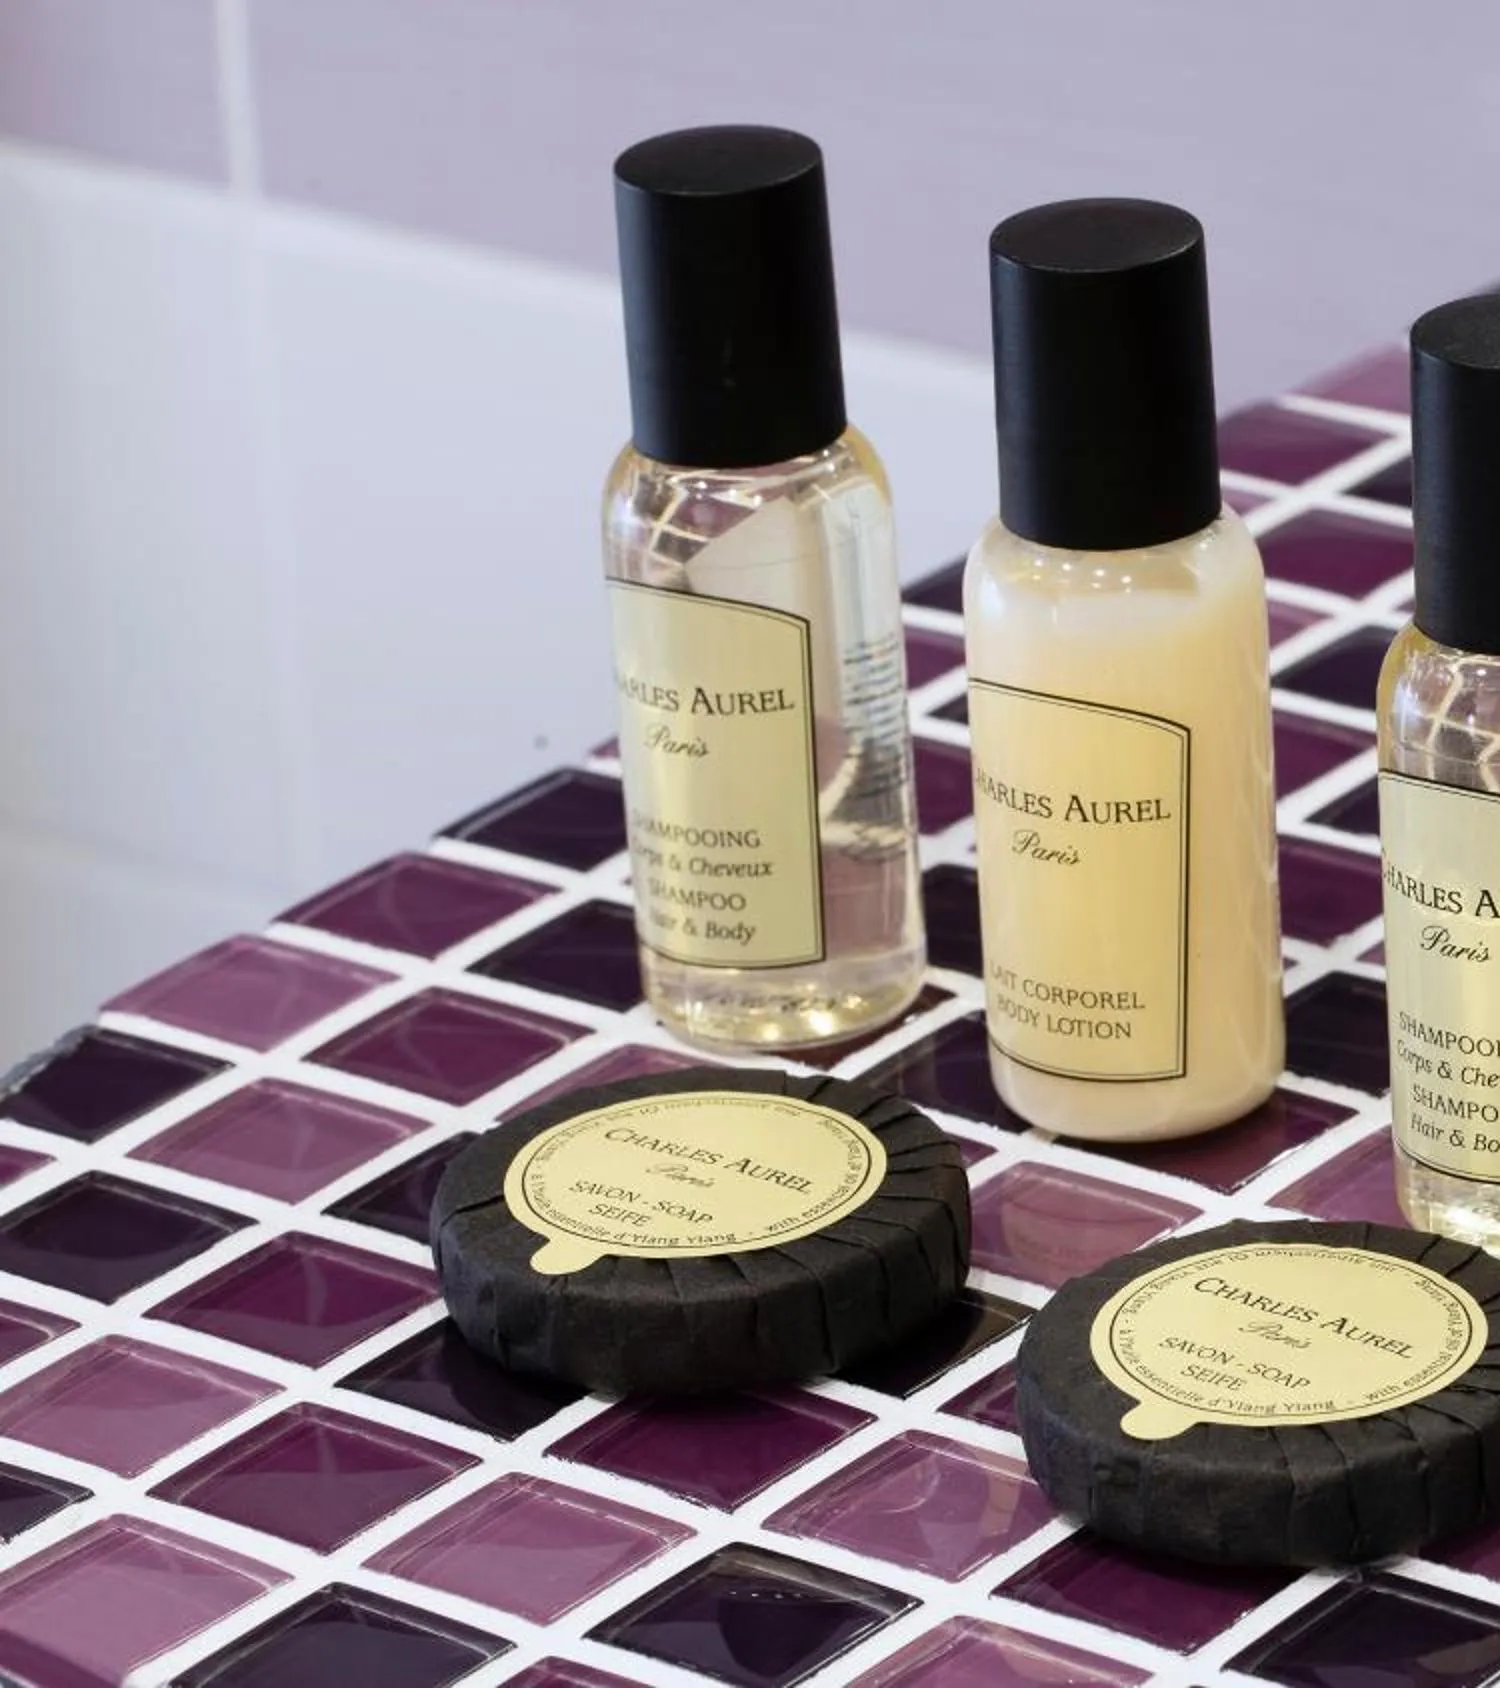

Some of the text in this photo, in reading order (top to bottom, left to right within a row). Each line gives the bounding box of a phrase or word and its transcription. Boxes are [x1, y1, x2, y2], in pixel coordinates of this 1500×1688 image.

[691, 686, 795, 716] AUREL
[646, 723, 708, 757] Paris
[976, 767, 1171, 824] HARLES AUREL
[1011, 829, 1080, 865] Paris
[689, 856, 773, 877] Cheveux
[649, 877, 746, 912] SHAMPOO
[682, 917, 697, 937] &
[705, 920, 756, 946] Body
[1419, 925, 1491, 963] Paris
[989, 960, 1145, 1010] LAIT CORPOREL
[997, 993, 1132, 1039] BODY LOTION
[1397, 1040, 1433, 1074] Corps
[1437, 1060, 1453, 1081] &
[1411, 1113, 1445, 1142] Hair
[1449, 1129, 1466, 1149] &
[604, 1127, 724, 1165] CHARLES
[723, 1157, 815, 1194] AUREL
[569, 1180, 641, 1203] SAVON
[651, 1200, 713, 1226] SOAP
[588, 1203, 652, 1227] SEIFE
[687, 1232, 737, 1246] Ylang
[765, 1216, 801, 1233] with
[1194, 1276, 1319, 1323] CHARLES
[1320, 1316, 1413, 1359] AUREL
[1158, 1336, 1235, 1365] SAVON
[1247, 1362, 1311, 1389] SOAP
[1180, 1364, 1247, 1391] SEIFE
[1283, 1400, 1336, 1413] Ylang
[1364, 1384, 1400, 1402] with
